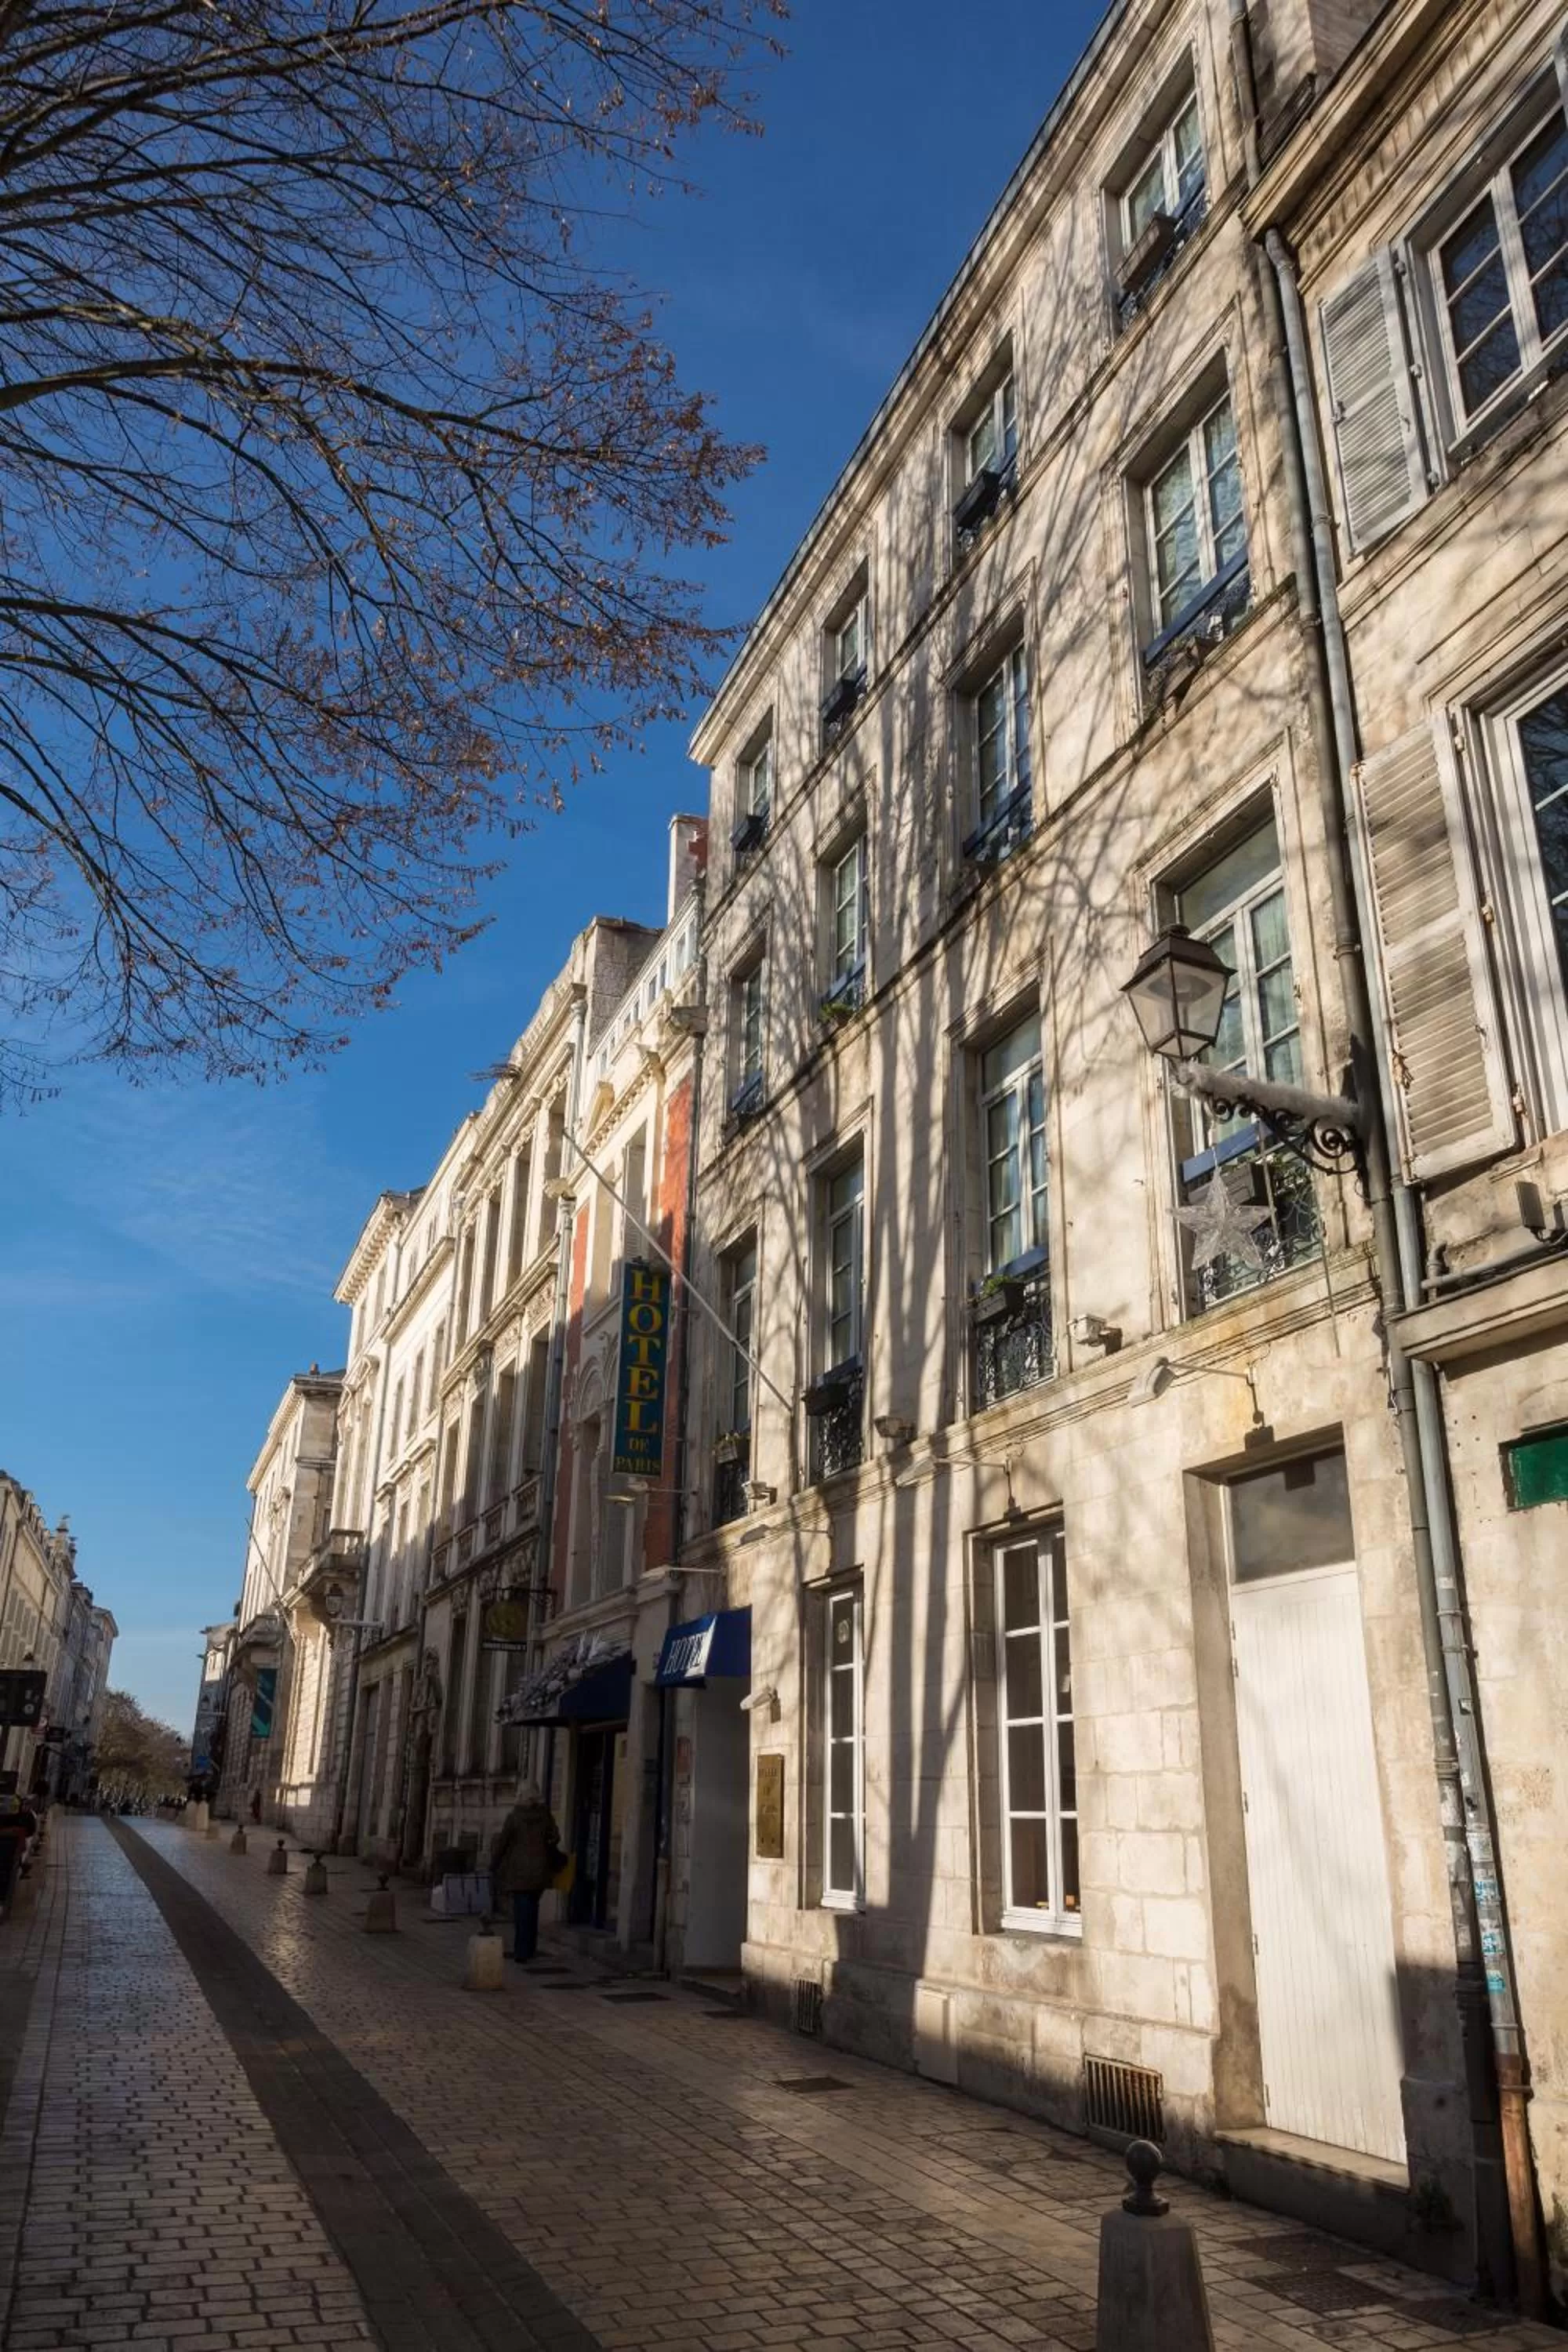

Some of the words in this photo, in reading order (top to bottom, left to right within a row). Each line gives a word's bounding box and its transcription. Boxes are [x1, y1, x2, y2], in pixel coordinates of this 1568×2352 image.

[625, 1269, 662, 1434] HOTEL
[629, 1438, 649, 1451] DE
[616, 1457, 660, 1473] PARIS
